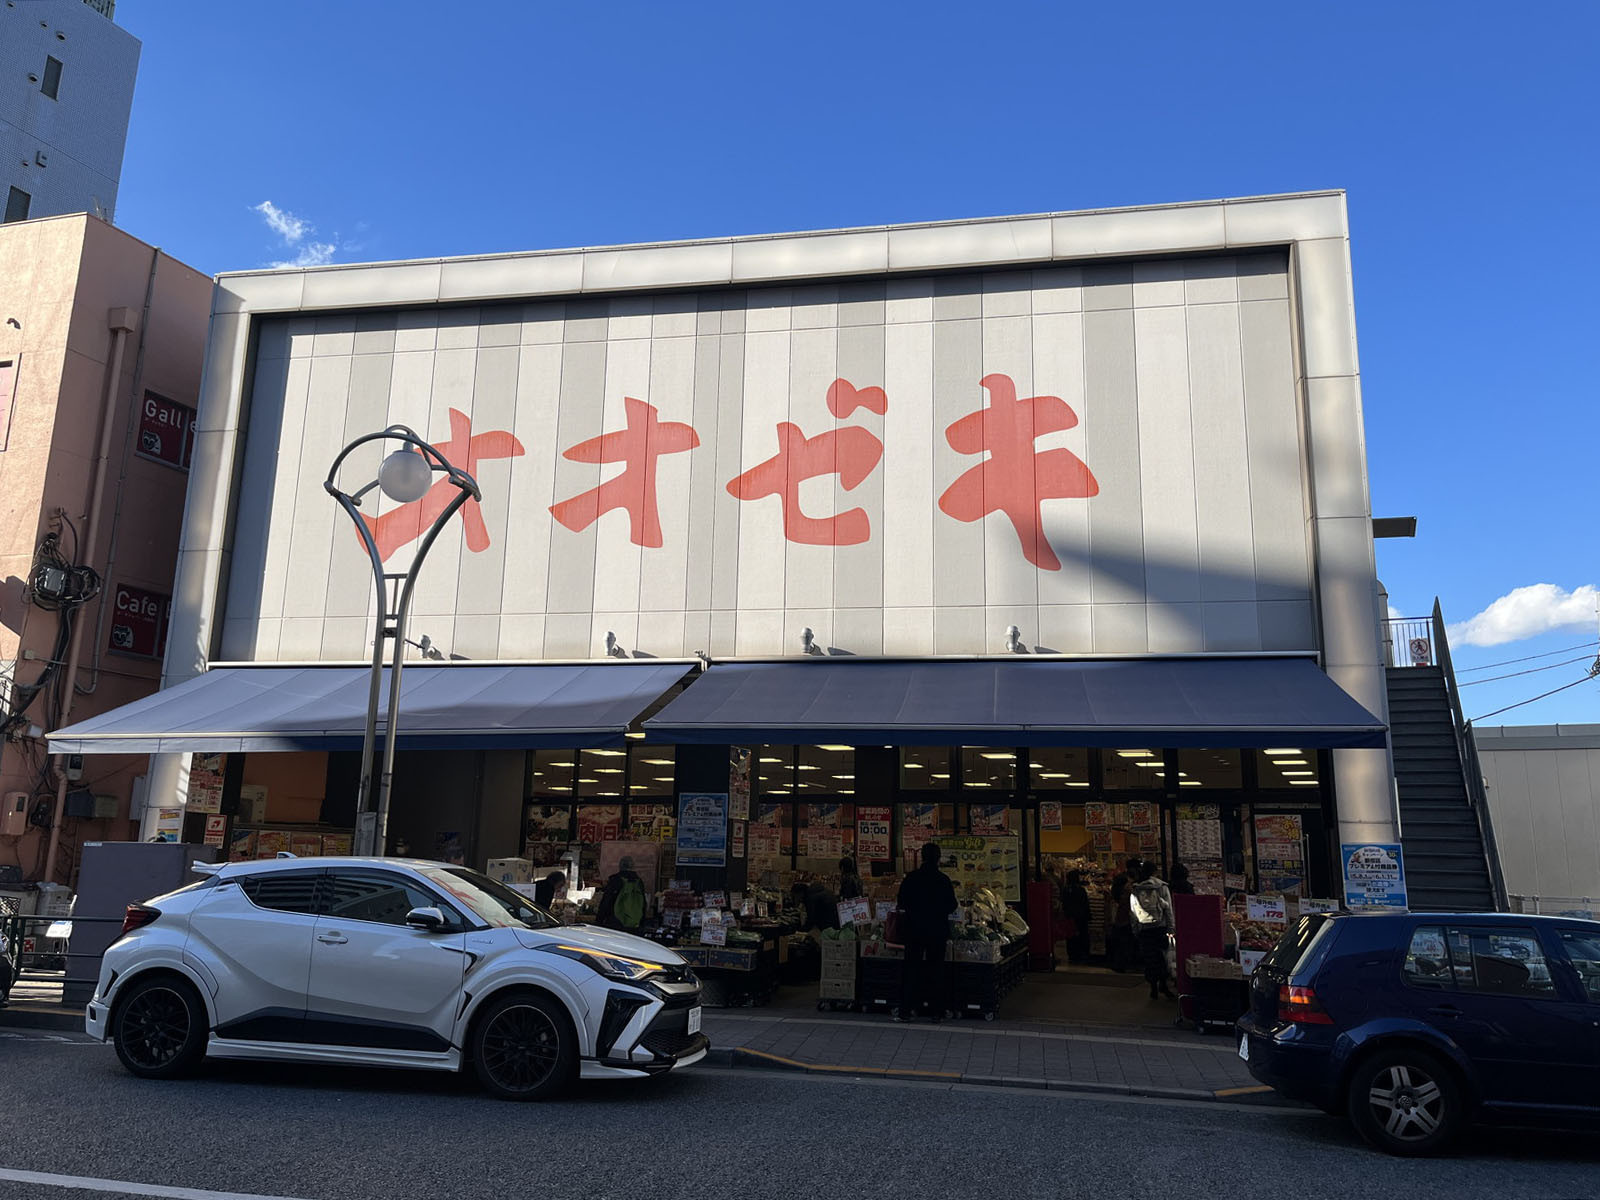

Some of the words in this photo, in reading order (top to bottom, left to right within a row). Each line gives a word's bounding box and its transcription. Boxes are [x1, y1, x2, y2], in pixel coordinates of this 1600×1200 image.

[355, 374, 1101, 571] オオゼキ
[117, 590, 158, 617] Cafe
[859, 826, 887, 834] 10:00
[859, 845, 887, 853] 22:00
